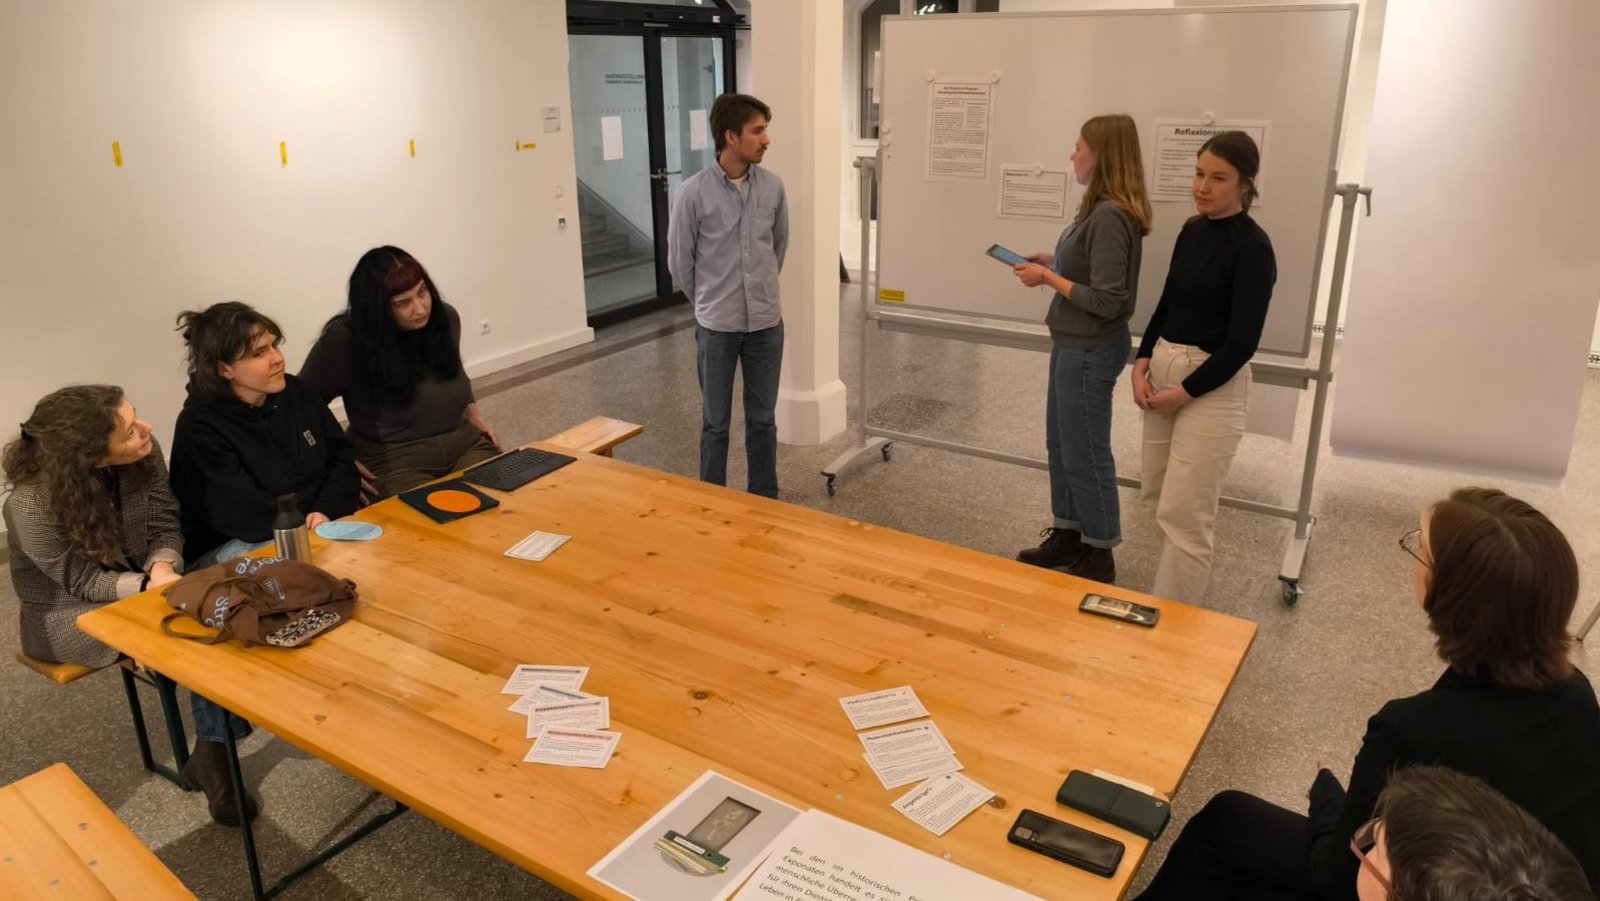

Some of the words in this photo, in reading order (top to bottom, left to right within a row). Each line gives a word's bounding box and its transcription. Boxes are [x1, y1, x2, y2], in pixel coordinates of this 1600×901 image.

[767, 874, 780, 883] für
[781, 880, 804, 893] ihren
[775, 865, 826, 890] menschliche
[783, 855, 826, 877] Exponaten
[829, 874, 862, 893] handelt
[864, 891, 876, 899] es
[790, 846, 805, 857] Bei
[809, 855, 826, 866] den
[832, 864, 844, 873] im
[850, 870, 902, 897] historischen
[759, 883, 785, 896] Leben
[785, 893, 794, 901] in
